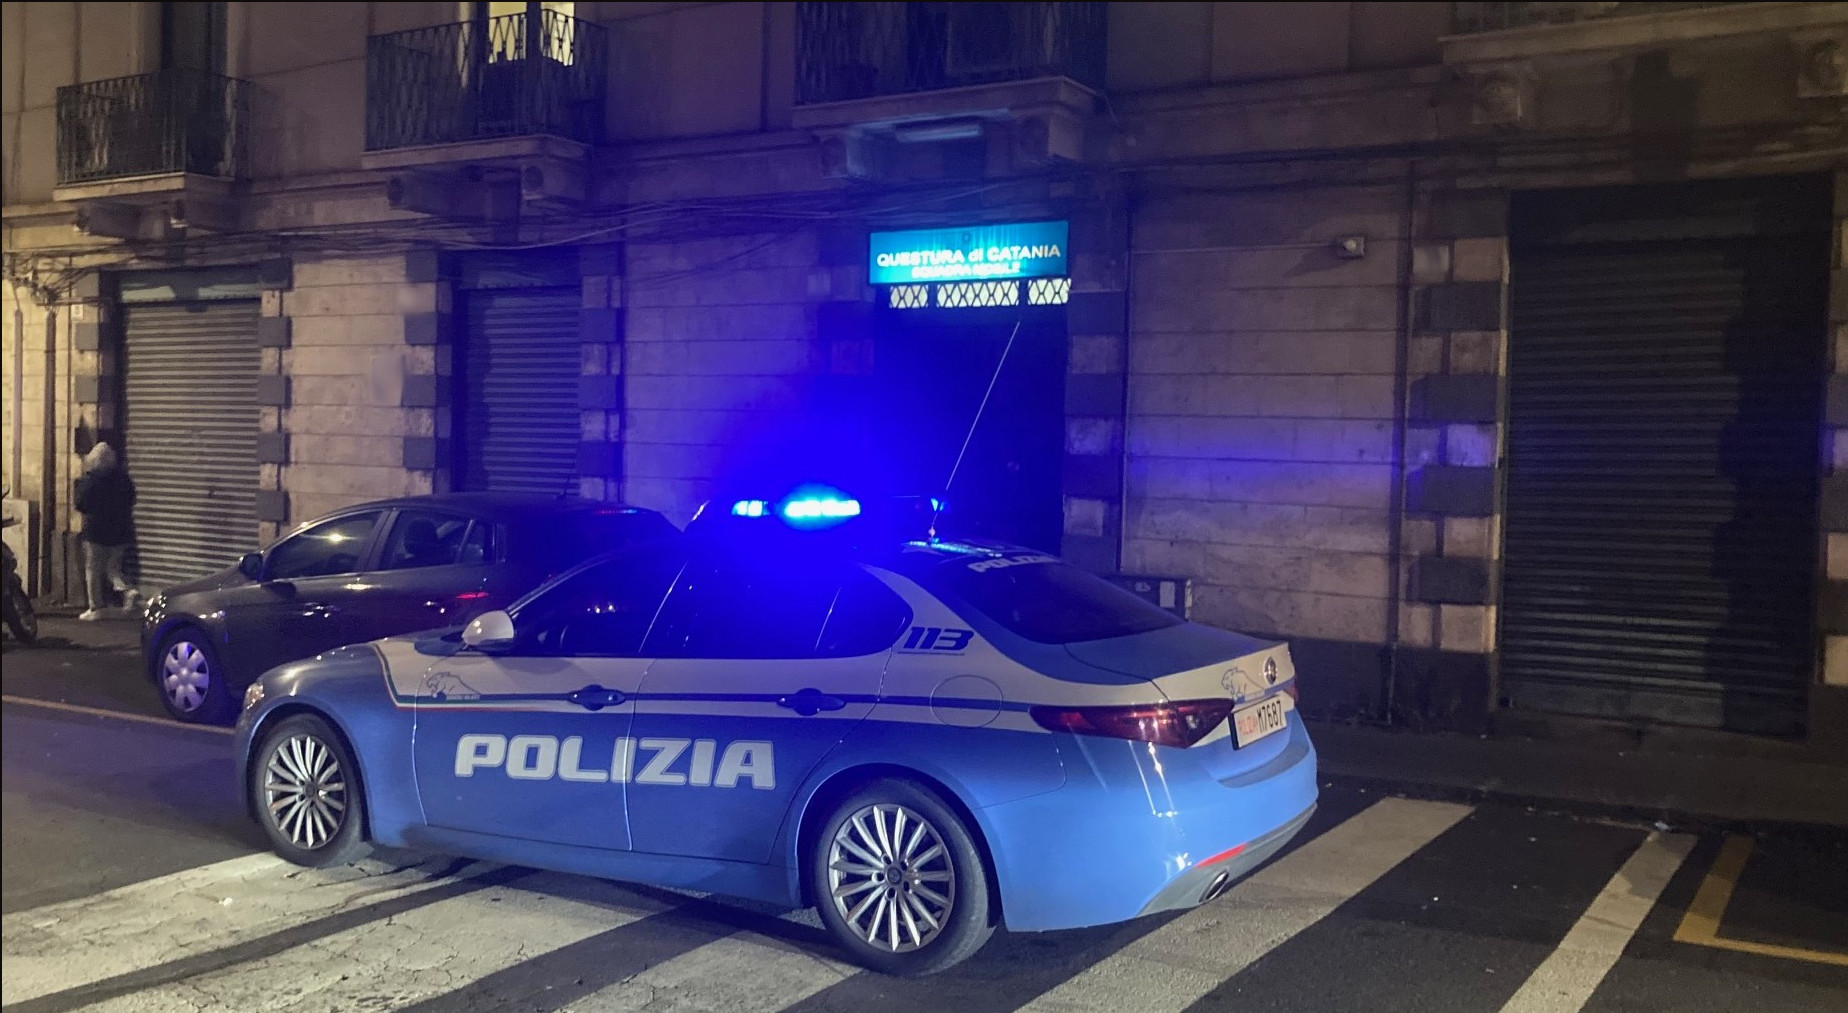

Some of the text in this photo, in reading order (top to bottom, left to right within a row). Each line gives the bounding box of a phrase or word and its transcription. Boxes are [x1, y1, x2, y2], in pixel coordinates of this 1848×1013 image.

[877, 244, 1061, 267] QUESTURA di CATANIA
[903, 626, 975, 651] 113
[1257, 700, 1283, 734] M7687
[454, 734, 776, 789] POLIZIA
